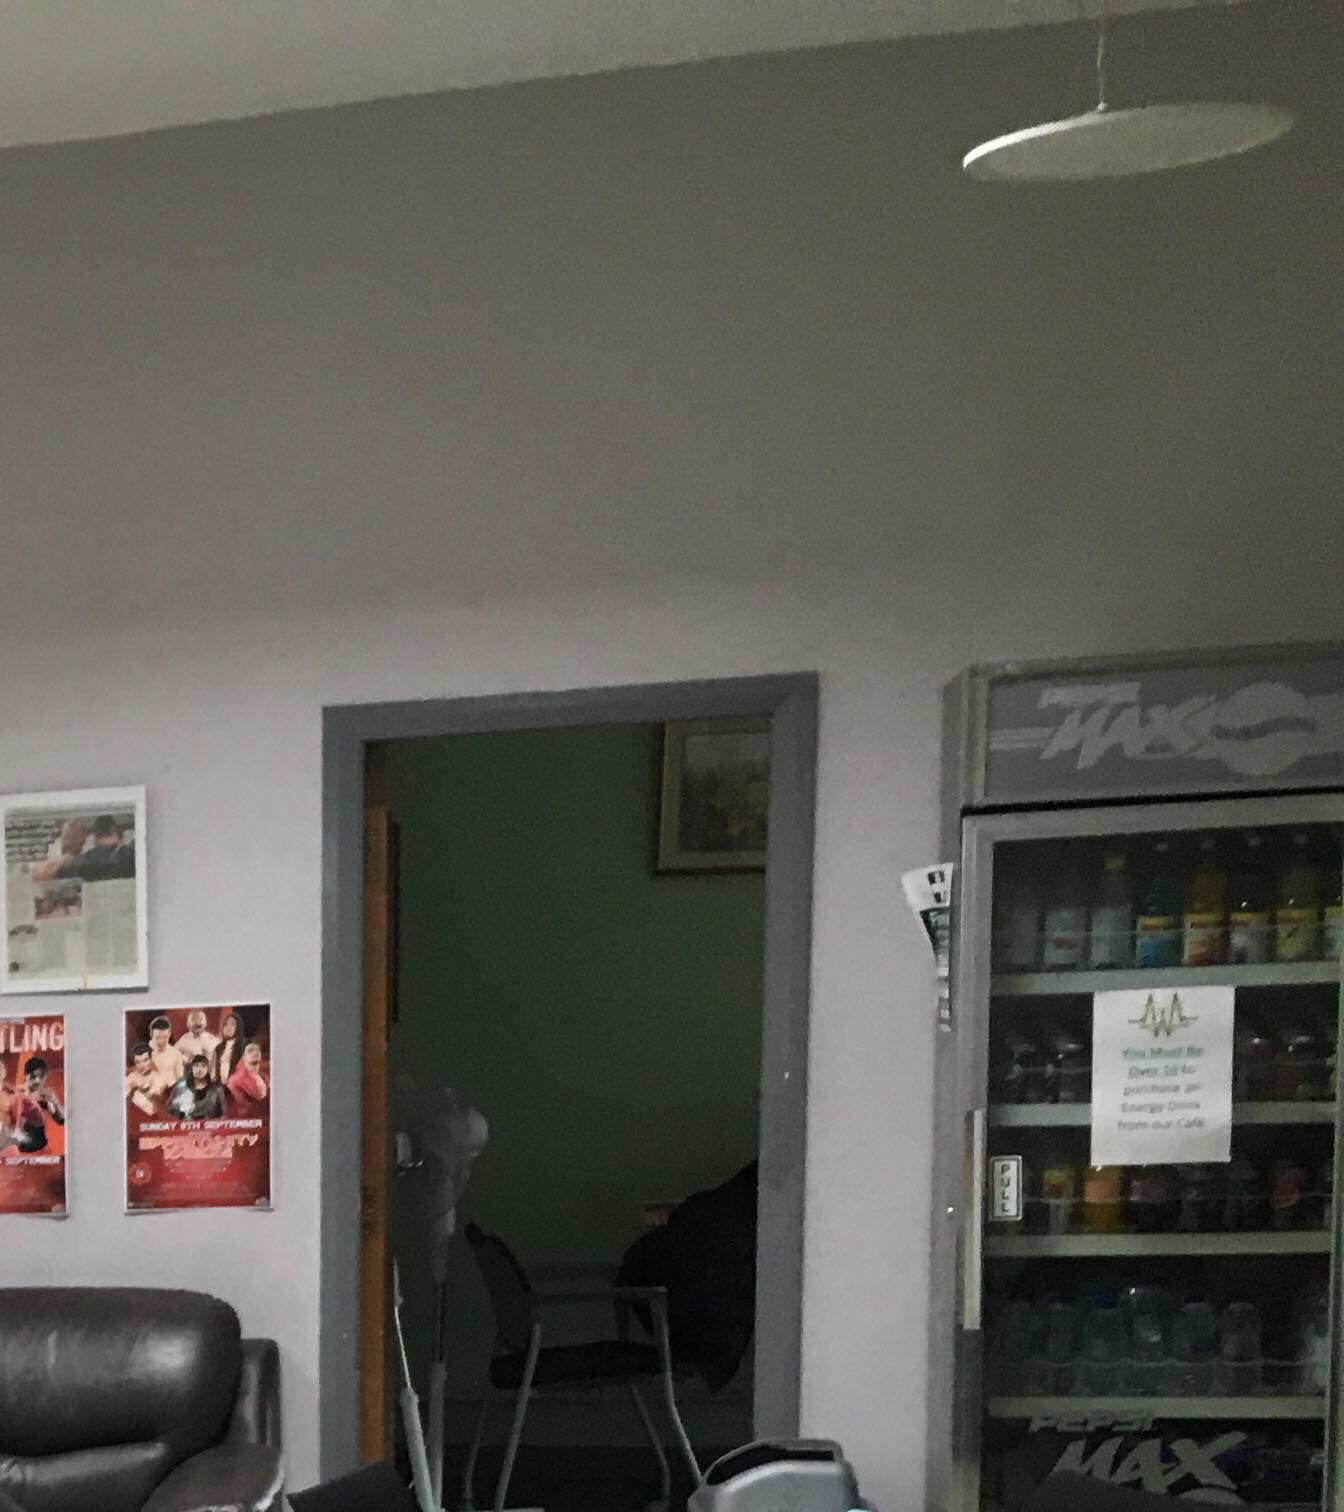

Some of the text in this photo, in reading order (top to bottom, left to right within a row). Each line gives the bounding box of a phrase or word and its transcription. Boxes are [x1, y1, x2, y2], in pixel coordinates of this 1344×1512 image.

[1121, 1047, 1145, 1059] You
[1150, 1046, 1182, 1058] Must
[1123, 1083, 1180, 1096] purchase
[1121, 1102, 1164, 1114] Energy
[139, 1122, 177, 1132] SUNDAY
[204, 1119, 263, 1129] SEPTEMBER
[6, 1155, 61, 1166] SEPTEMBER
[1000, 1163, 1011, 1213] PULL
[1046, 1430, 1249, 1495] MAX
